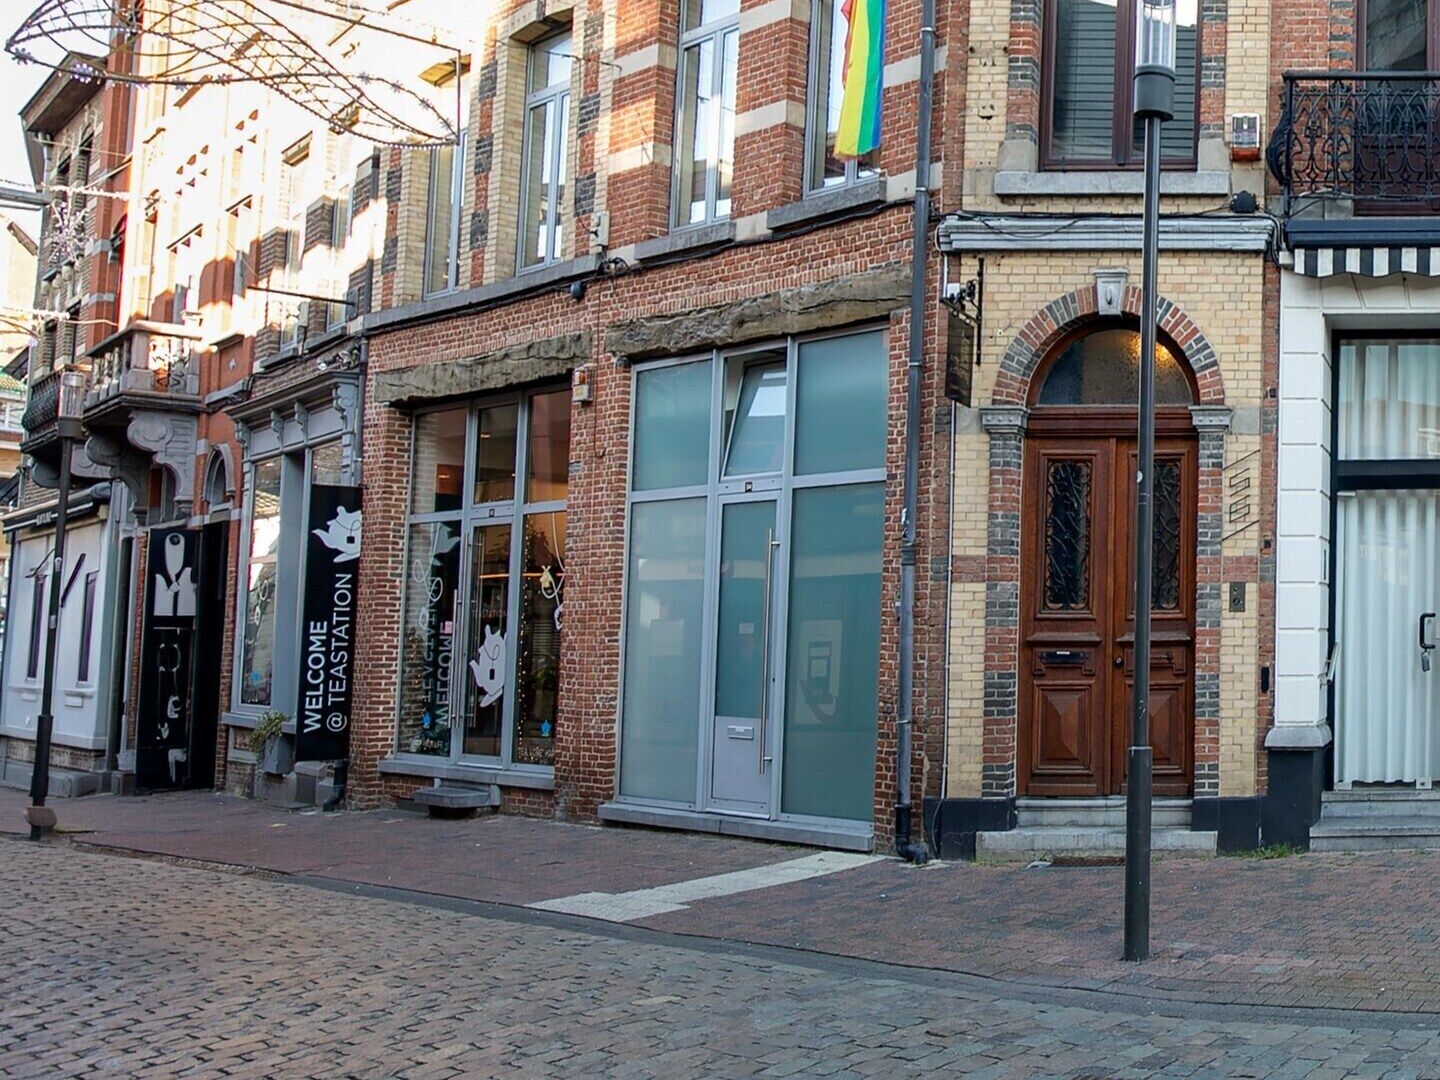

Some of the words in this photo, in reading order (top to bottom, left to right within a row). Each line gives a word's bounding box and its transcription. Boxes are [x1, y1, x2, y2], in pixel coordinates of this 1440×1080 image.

[303, 620, 328, 734] WELCOME
[327, 573, 353, 705] TEASTATION
[326, 711, 348, 733] @
